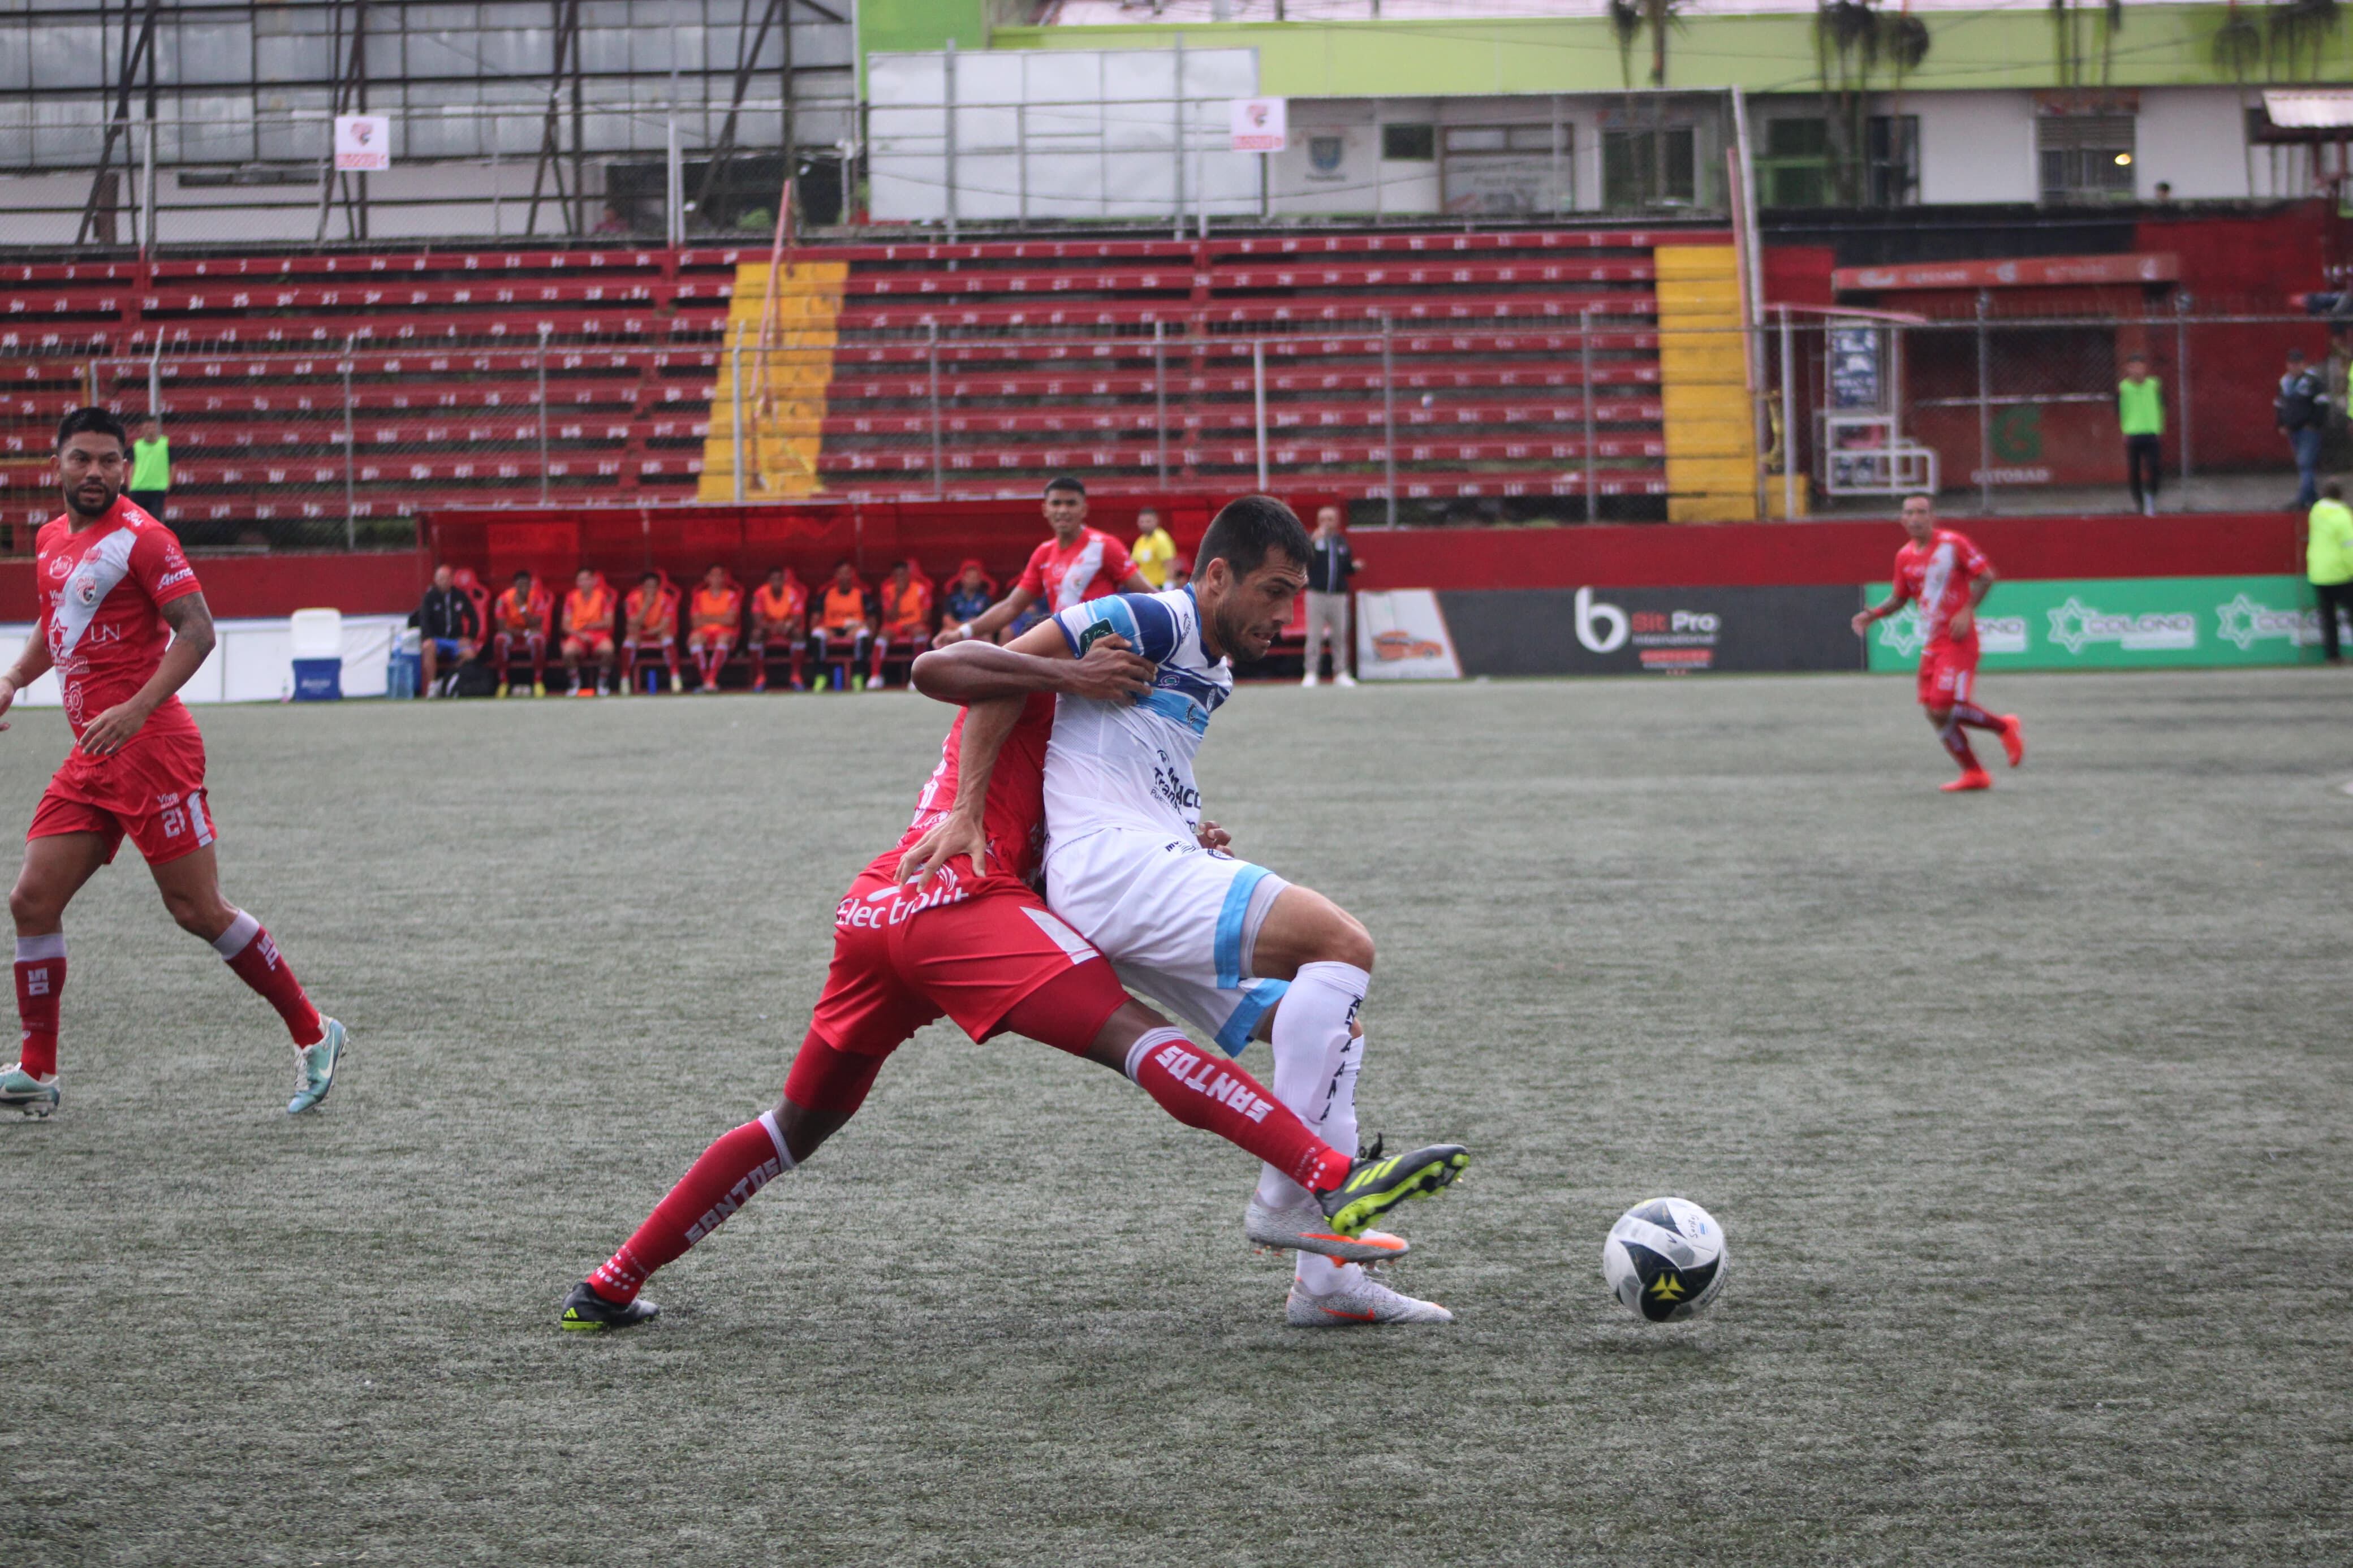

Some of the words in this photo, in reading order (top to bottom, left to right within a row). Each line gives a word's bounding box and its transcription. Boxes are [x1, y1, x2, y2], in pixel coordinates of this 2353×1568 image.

[1631, 611, 1666, 633] Bit
[1671, 610, 1718, 632] Pro
[2088, 615, 2191, 633] COLONO
[162, 806, 186, 838] 21
[1154, 1045, 1274, 1124] SANTOS
[684, 1156, 779, 1245] SANTOS
